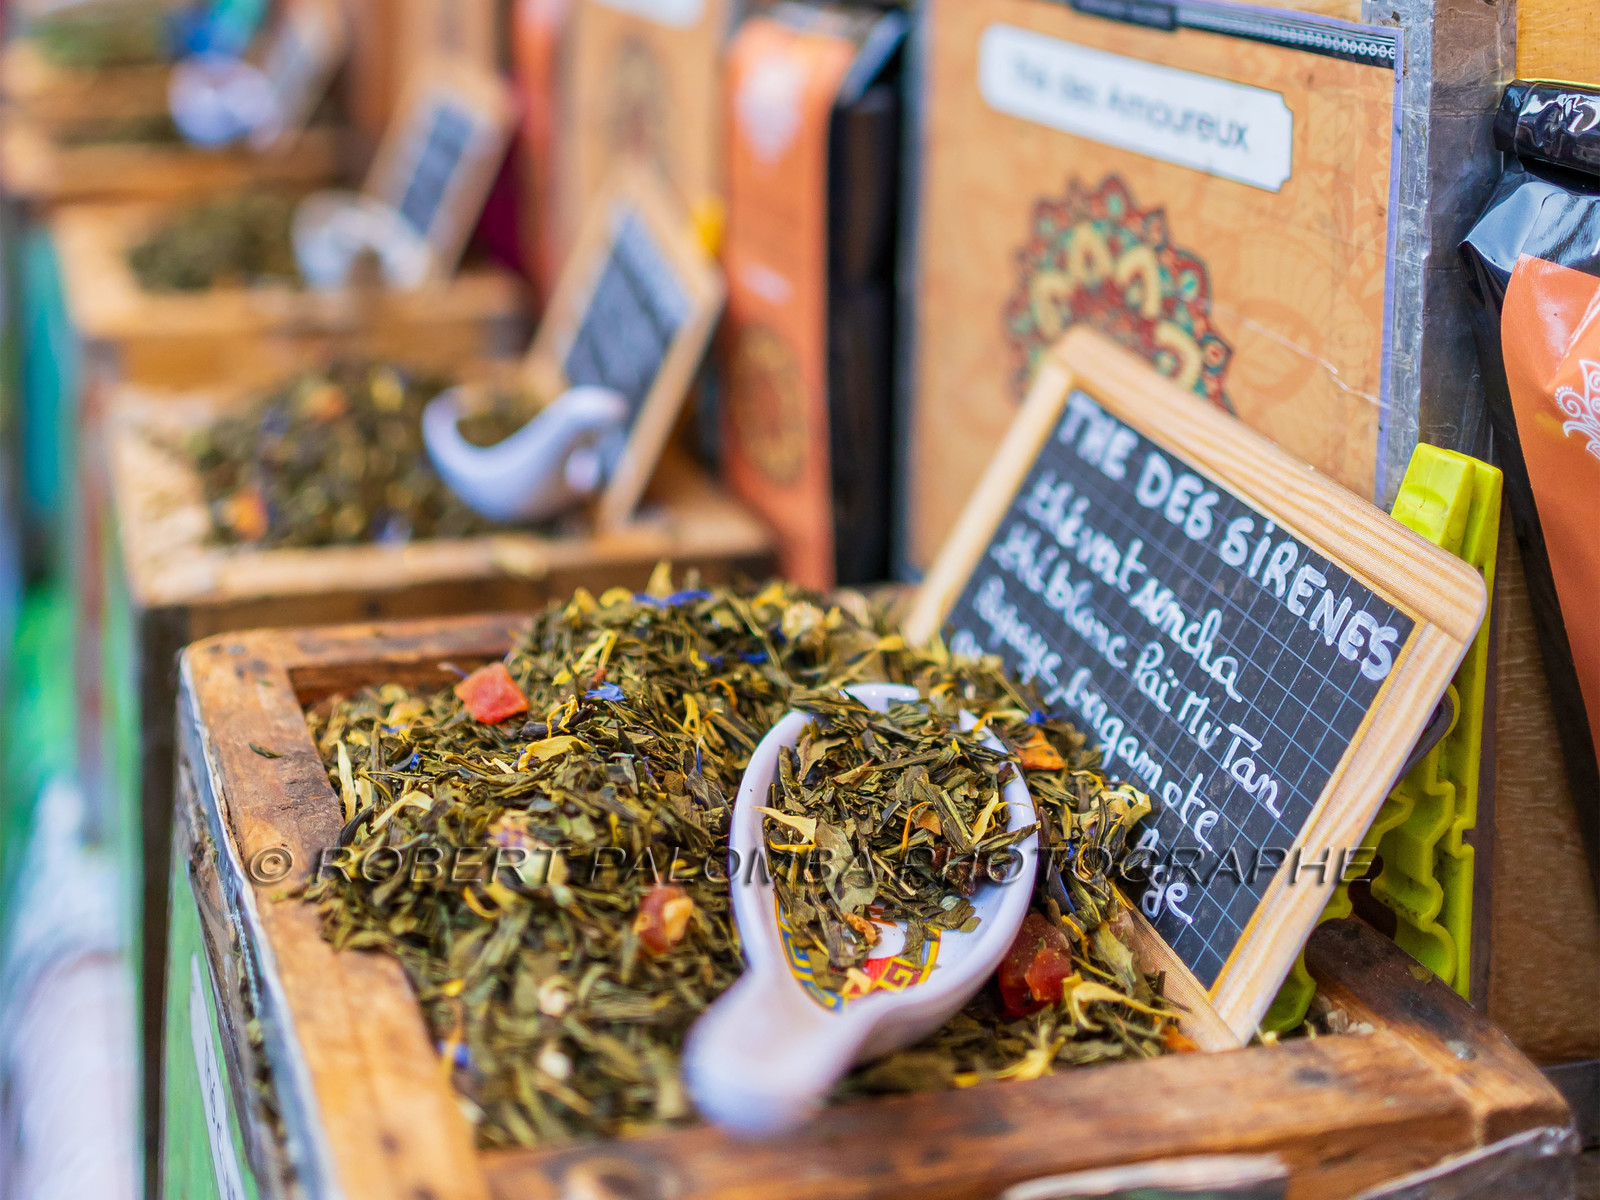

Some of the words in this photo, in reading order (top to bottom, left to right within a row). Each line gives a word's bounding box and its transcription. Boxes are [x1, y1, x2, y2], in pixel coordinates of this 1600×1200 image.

[1134, 451, 1220, 541] DES
[1043, 559, 1128, 669] blanc
[1221, 723, 1282, 819] Tan
[1075, 526, 1148, 594] vert
[1128, 576, 1243, 703] sencha
